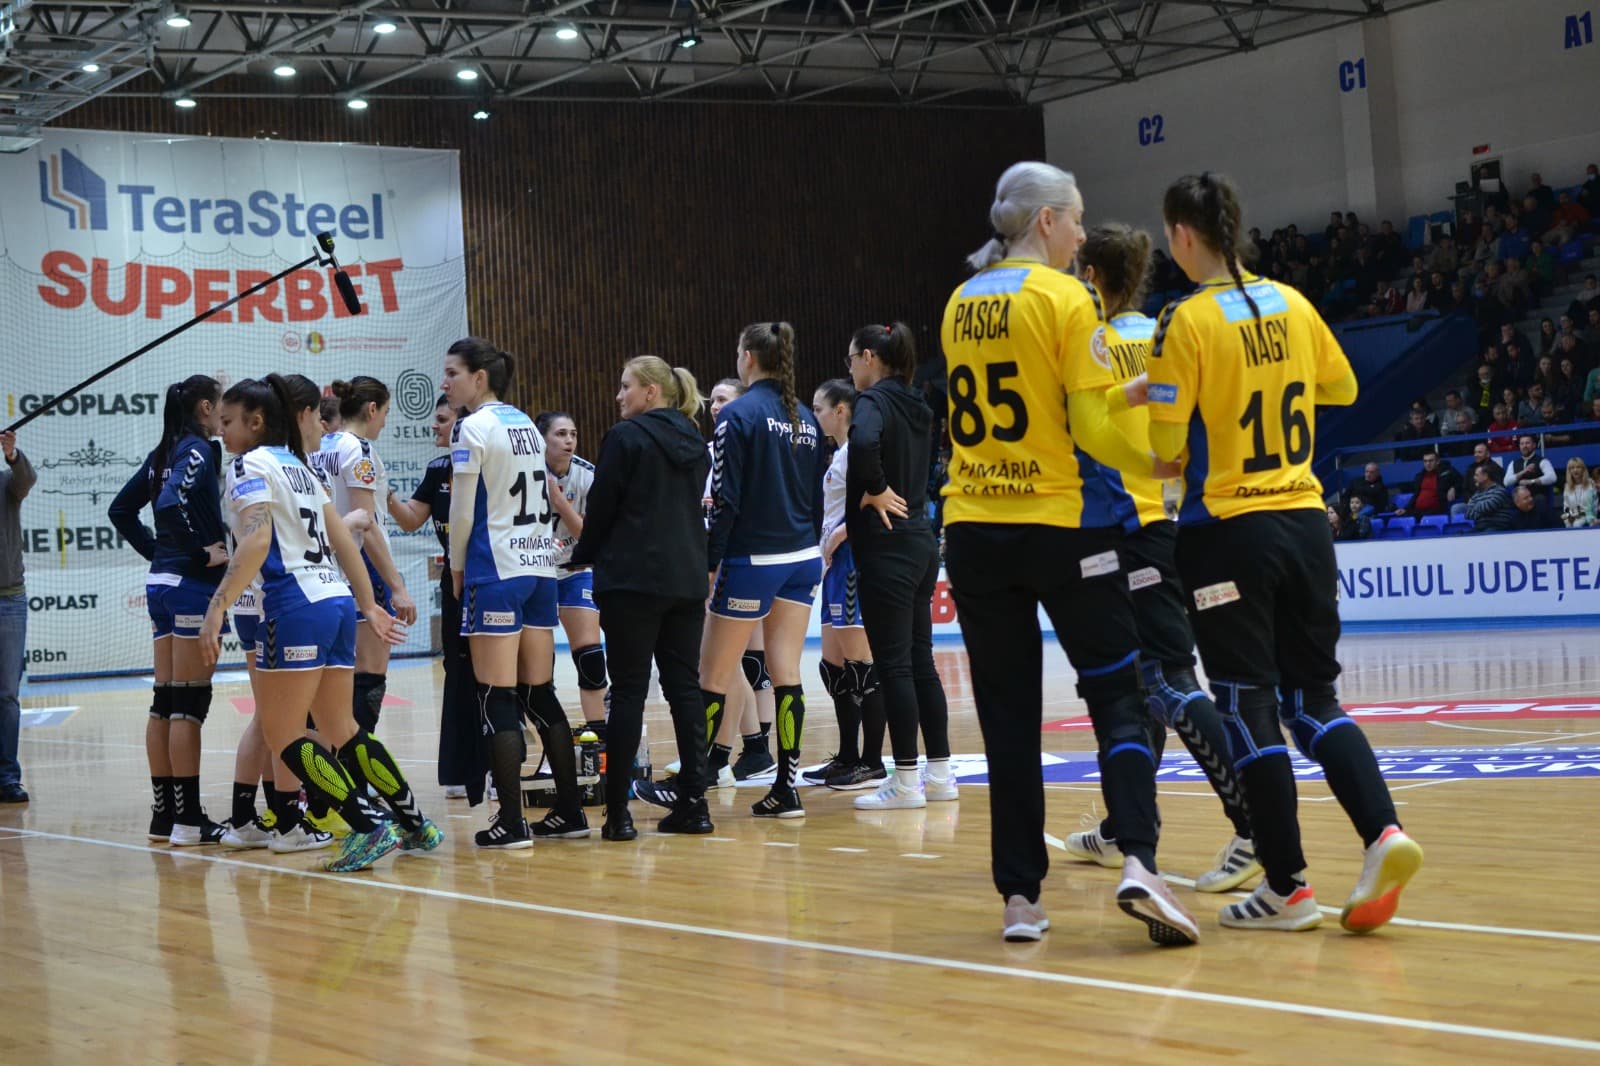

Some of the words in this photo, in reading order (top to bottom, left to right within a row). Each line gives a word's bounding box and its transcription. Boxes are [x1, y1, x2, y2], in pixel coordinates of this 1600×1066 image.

[1564, 11, 1593, 49] A1
[1339, 58, 1367, 93] C1
[1138, 114, 1165, 146] C2
[118, 184, 384, 240] TeraSteel
[37, 249, 404, 324] SUPERBET
[1239, 317, 1290, 369] NAGY
[19, 393, 159, 417] GEOPLAST
[949, 361, 1029, 447] 85
[1239, 381, 1311, 474] 16
[509, 470, 552, 526] 13
[28, 594, 98, 612] OPLAST
[1464, 556, 1600, 602] JUDEȚE
